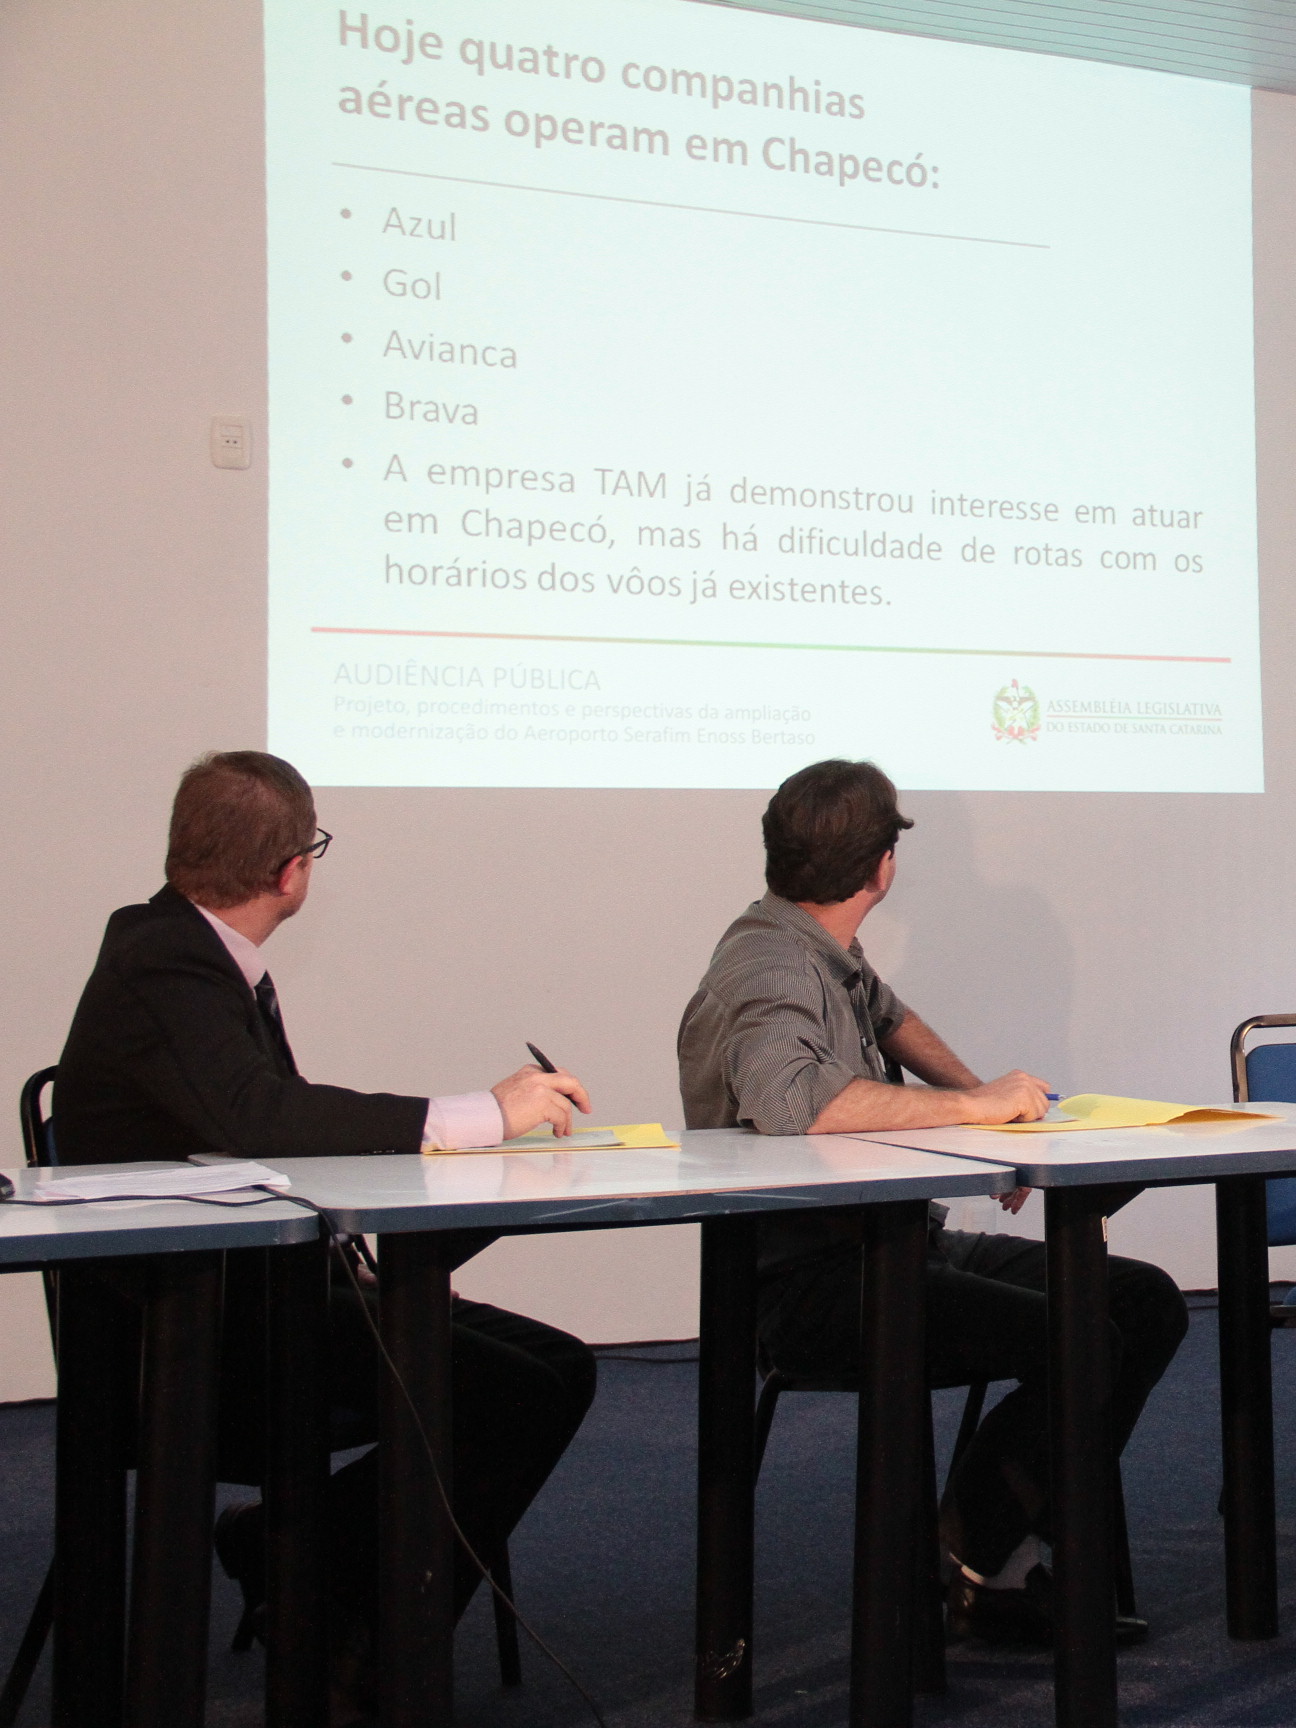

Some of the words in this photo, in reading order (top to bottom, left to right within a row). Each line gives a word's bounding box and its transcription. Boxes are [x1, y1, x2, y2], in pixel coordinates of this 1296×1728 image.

[338, 9, 444, 66] Hoje
[458, 37, 606, 84] quatro
[621, 61, 866, 120] companhias
[338, 79, 490, 133] aéreas
[504, 109, 670, 156] operam
[685, 134, 748, 167] em
[761, 136, 940, 190] Chapecó:
[381, 206, 456, 242] Azul
[382, 268, 441, 301] Gol
[382, 329, 518, 369] Avianca
[384, 390, 479, 426] Brava
[383, 453, 408, 483] A
[426, 463, 576, 495] empresa
[593, 467, 667, 499] TAM
[683, 473, 712, 508] já
[729, 476, 914, 514] demonstrou
[931, 489, 1060, 523] interesse
[1074, 504, 1116, 525] em
[1131, 504, 1204, 530] atuar
[383, 510, 439, 535] em
[460, 507, 616, 550] Chapecó,
[637, 525, 702, 550] mas
[722, 521, 758, 552] há
[777, 525, 943, 562] dificuldade
[960, 535, 996, 564] de
[1013, 542, 1083, 568] rotas
[1099, 549, 1157, 572] com
[1173, 553, 1204, 574] os
[384, 553, 528, 591] horários
[536, 561, 596, 594] dos
[606, 565, 683, 598] vôos
[689, 569, 718, 605] já
[728, 573, 892, 606] existentes.
[332, 658, 485, 688] AUDIÊNCIA
[492, 661, 602, 691] PÚBLICA
[416, 698, 560, 718] procedimentos
[563, 703, 577, 718] e
[581, 702, 694, 721] perspectivas
[697, 703, 720, 720] da
[723, 704, 812, 726] ampliação
[1047, 698, 1132, 714] ASSEMBLÉIA
[1137, 702, 1222, 716] LEGISLATIVA
[331, 724, 346, 739] e
[350, 721, 489, 744] modernização
[493, 723, 519, 742] do
[523, 724, 620, 746] Aeroporto
[623, 725, 692, 744] Serafim
[696, 726, 747, 745] Enoss
[750, 728, 816, 746] Bertaso
[1046, 722, 1064, 732] DO
[1068, 722, 1111, 733] ESTADO
[1114, 723, 1128, 734] DE
[1132, 723, 1166, 734] SANTA
[1169, 724, 1222, 735] CATARINA
